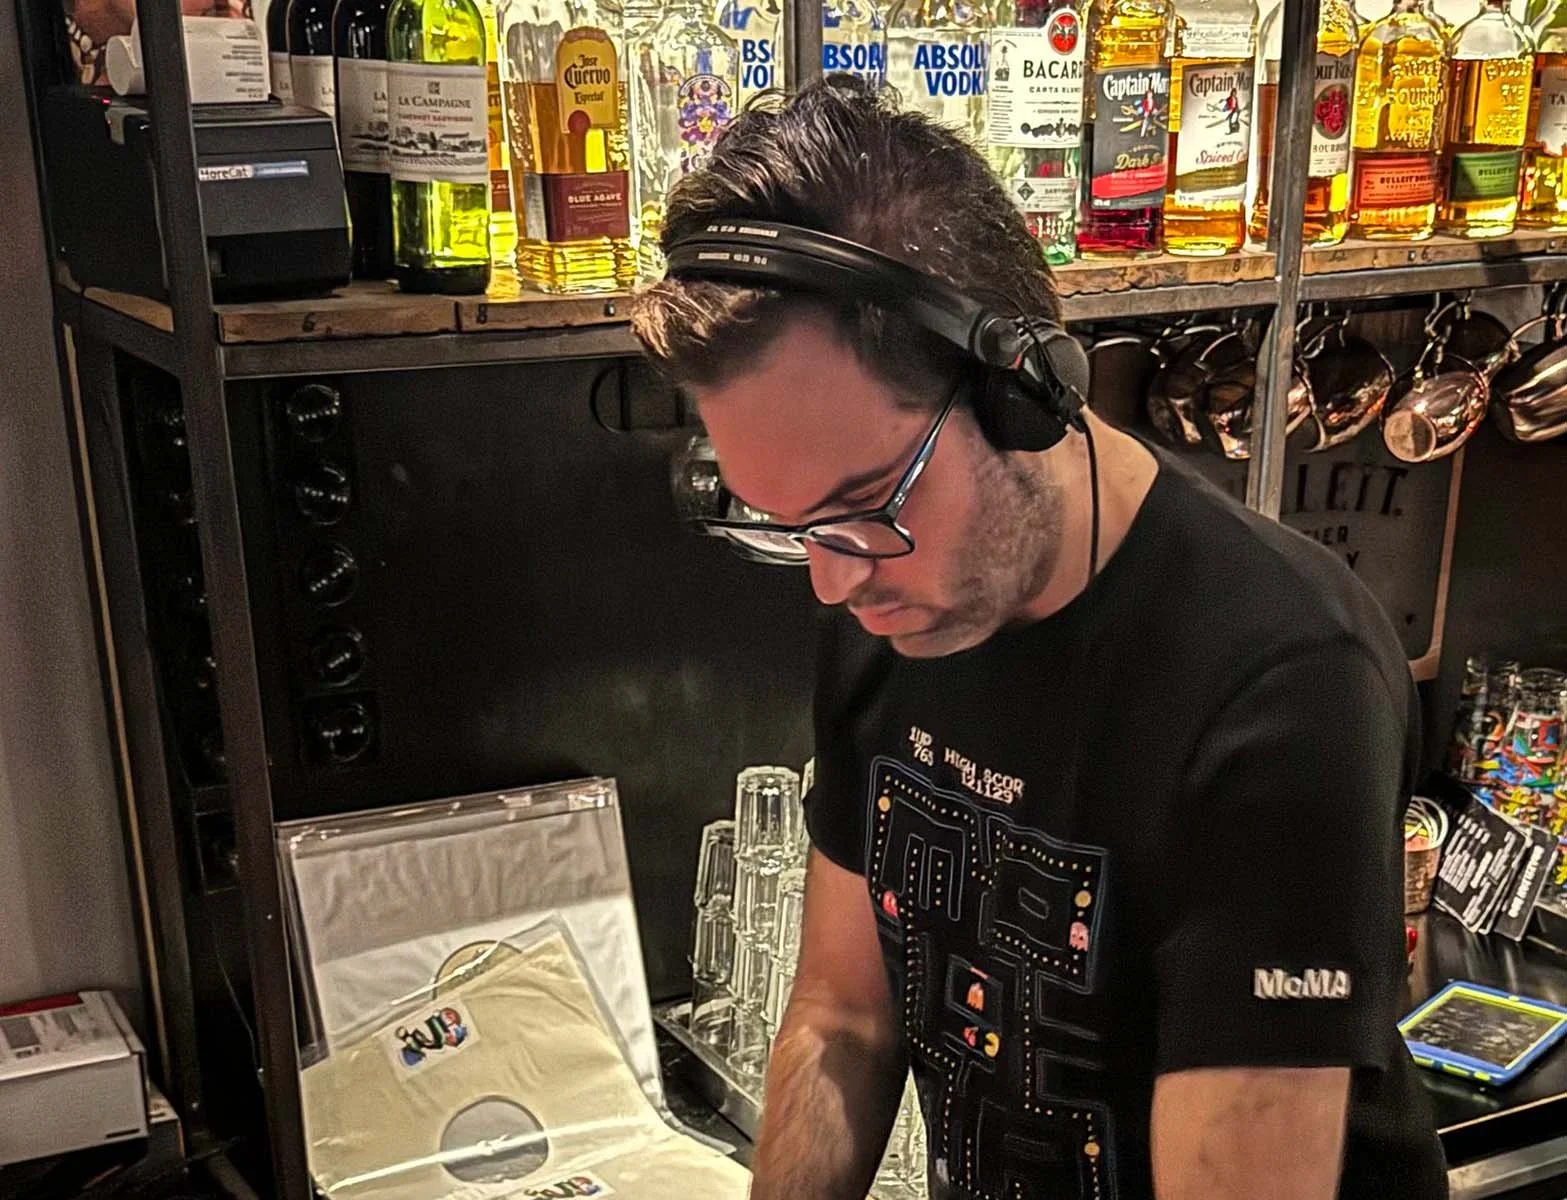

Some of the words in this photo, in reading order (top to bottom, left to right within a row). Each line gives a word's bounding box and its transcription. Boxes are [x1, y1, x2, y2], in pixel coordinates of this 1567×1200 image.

[564, 64, 611, 89] Cuervo
[1103, 72, 1150, 100] Captain
[1189, 72, 1234, 97] Captain
[398, 96, 410, 106] LA
[412, 96, 472, 108] CAMPAGNE
[1115, 154, 1150, 169] Dark
[1198, 151, 1232, 164] Spiced
[567, 194, 593, 203] BLUE
[594, 193, 622, 202] AGAVE
[944, 748, 976, 778] HIGH
[983, 768, 1024, 797] SCOR
[1254, 969, 1348, 999] MoMA
